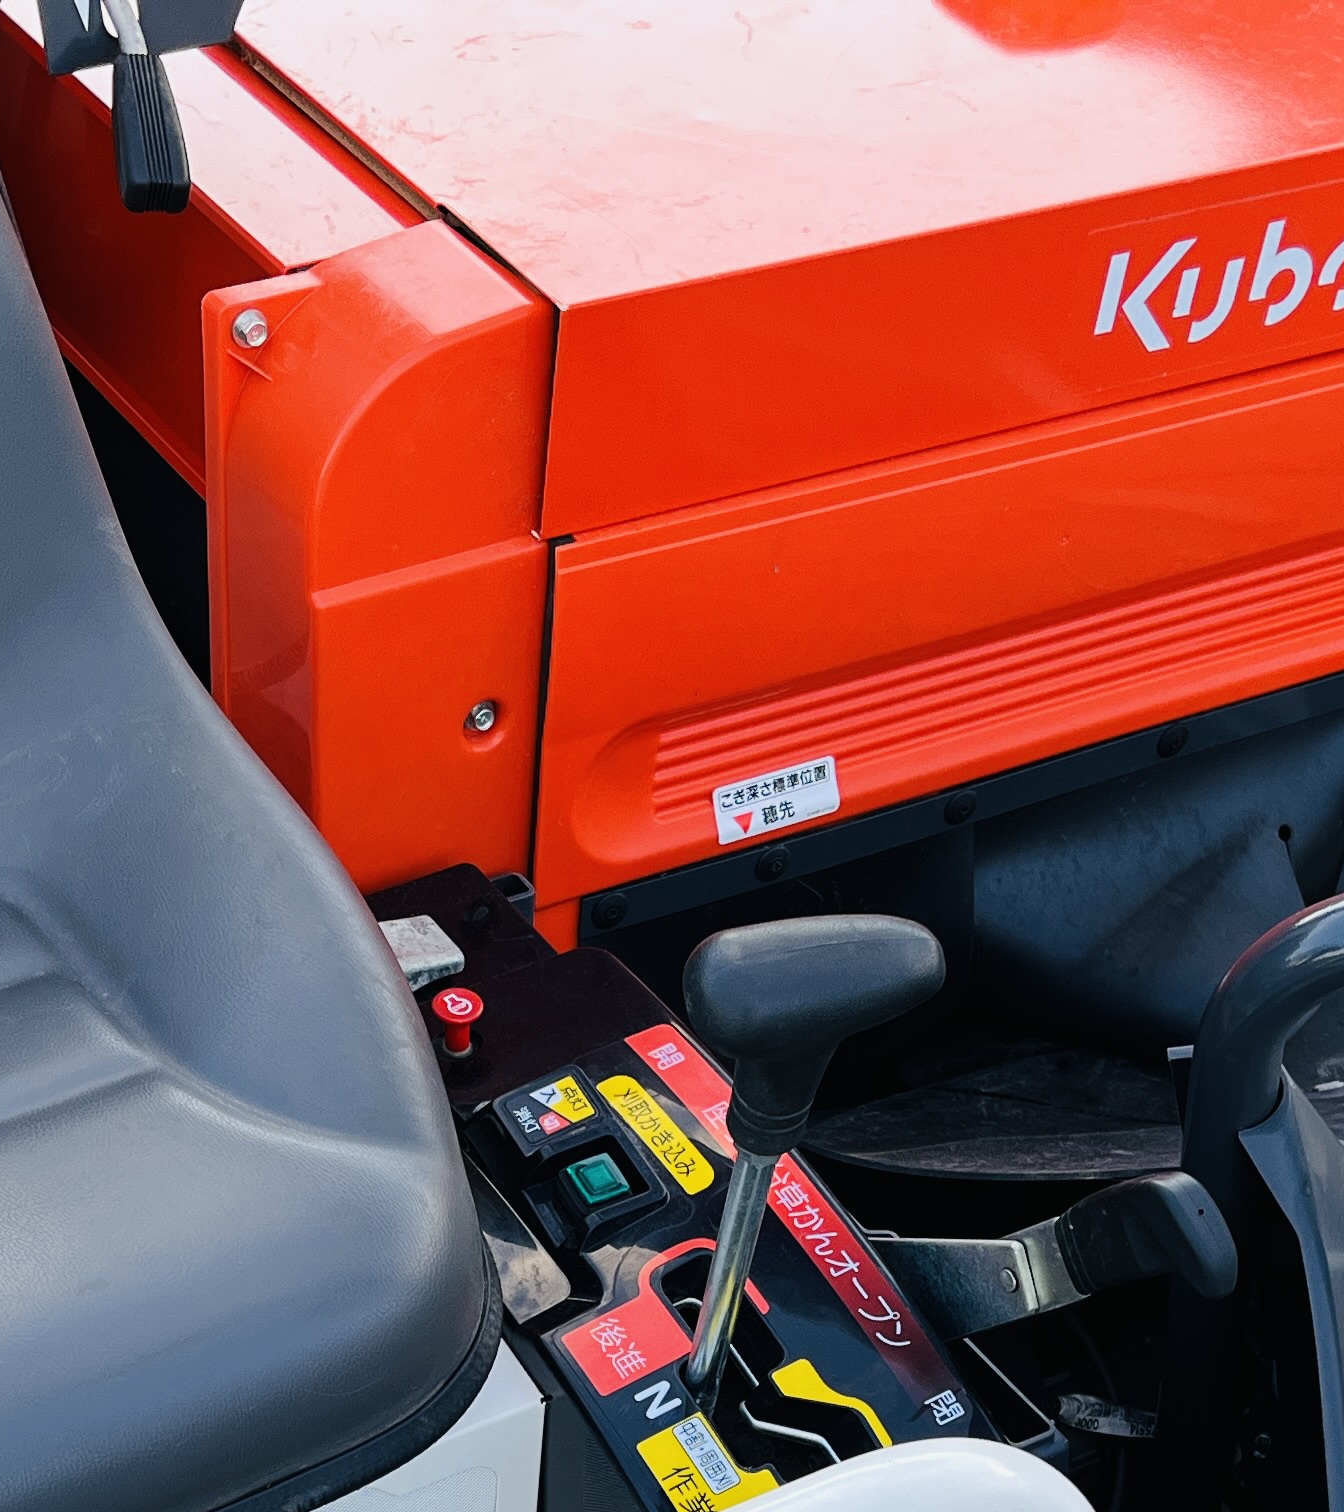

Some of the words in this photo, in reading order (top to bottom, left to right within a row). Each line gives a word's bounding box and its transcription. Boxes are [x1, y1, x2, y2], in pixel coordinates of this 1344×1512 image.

[721, 764, 826, 808] こぎ深さ標準位置
[762, 800, 796, 825] 穂先
[646, 1042, 686, 1071] 開
[540, 1088, 559, 1104] 入
[559, 1086, 590, 1112] 点灯
[511, 1104, 542, 1134] 消灯
[540, 1115, 561, 1133] 切
[612, 1087, 698, 1178] 刈取かき込み
[587, 1316, 649, 1380] 後進
[633, 1379, 683, 1421] N
[923, 1388, 965, 1427] 閉
[677, 1421, 736, 1491] 中割・周囲刈
